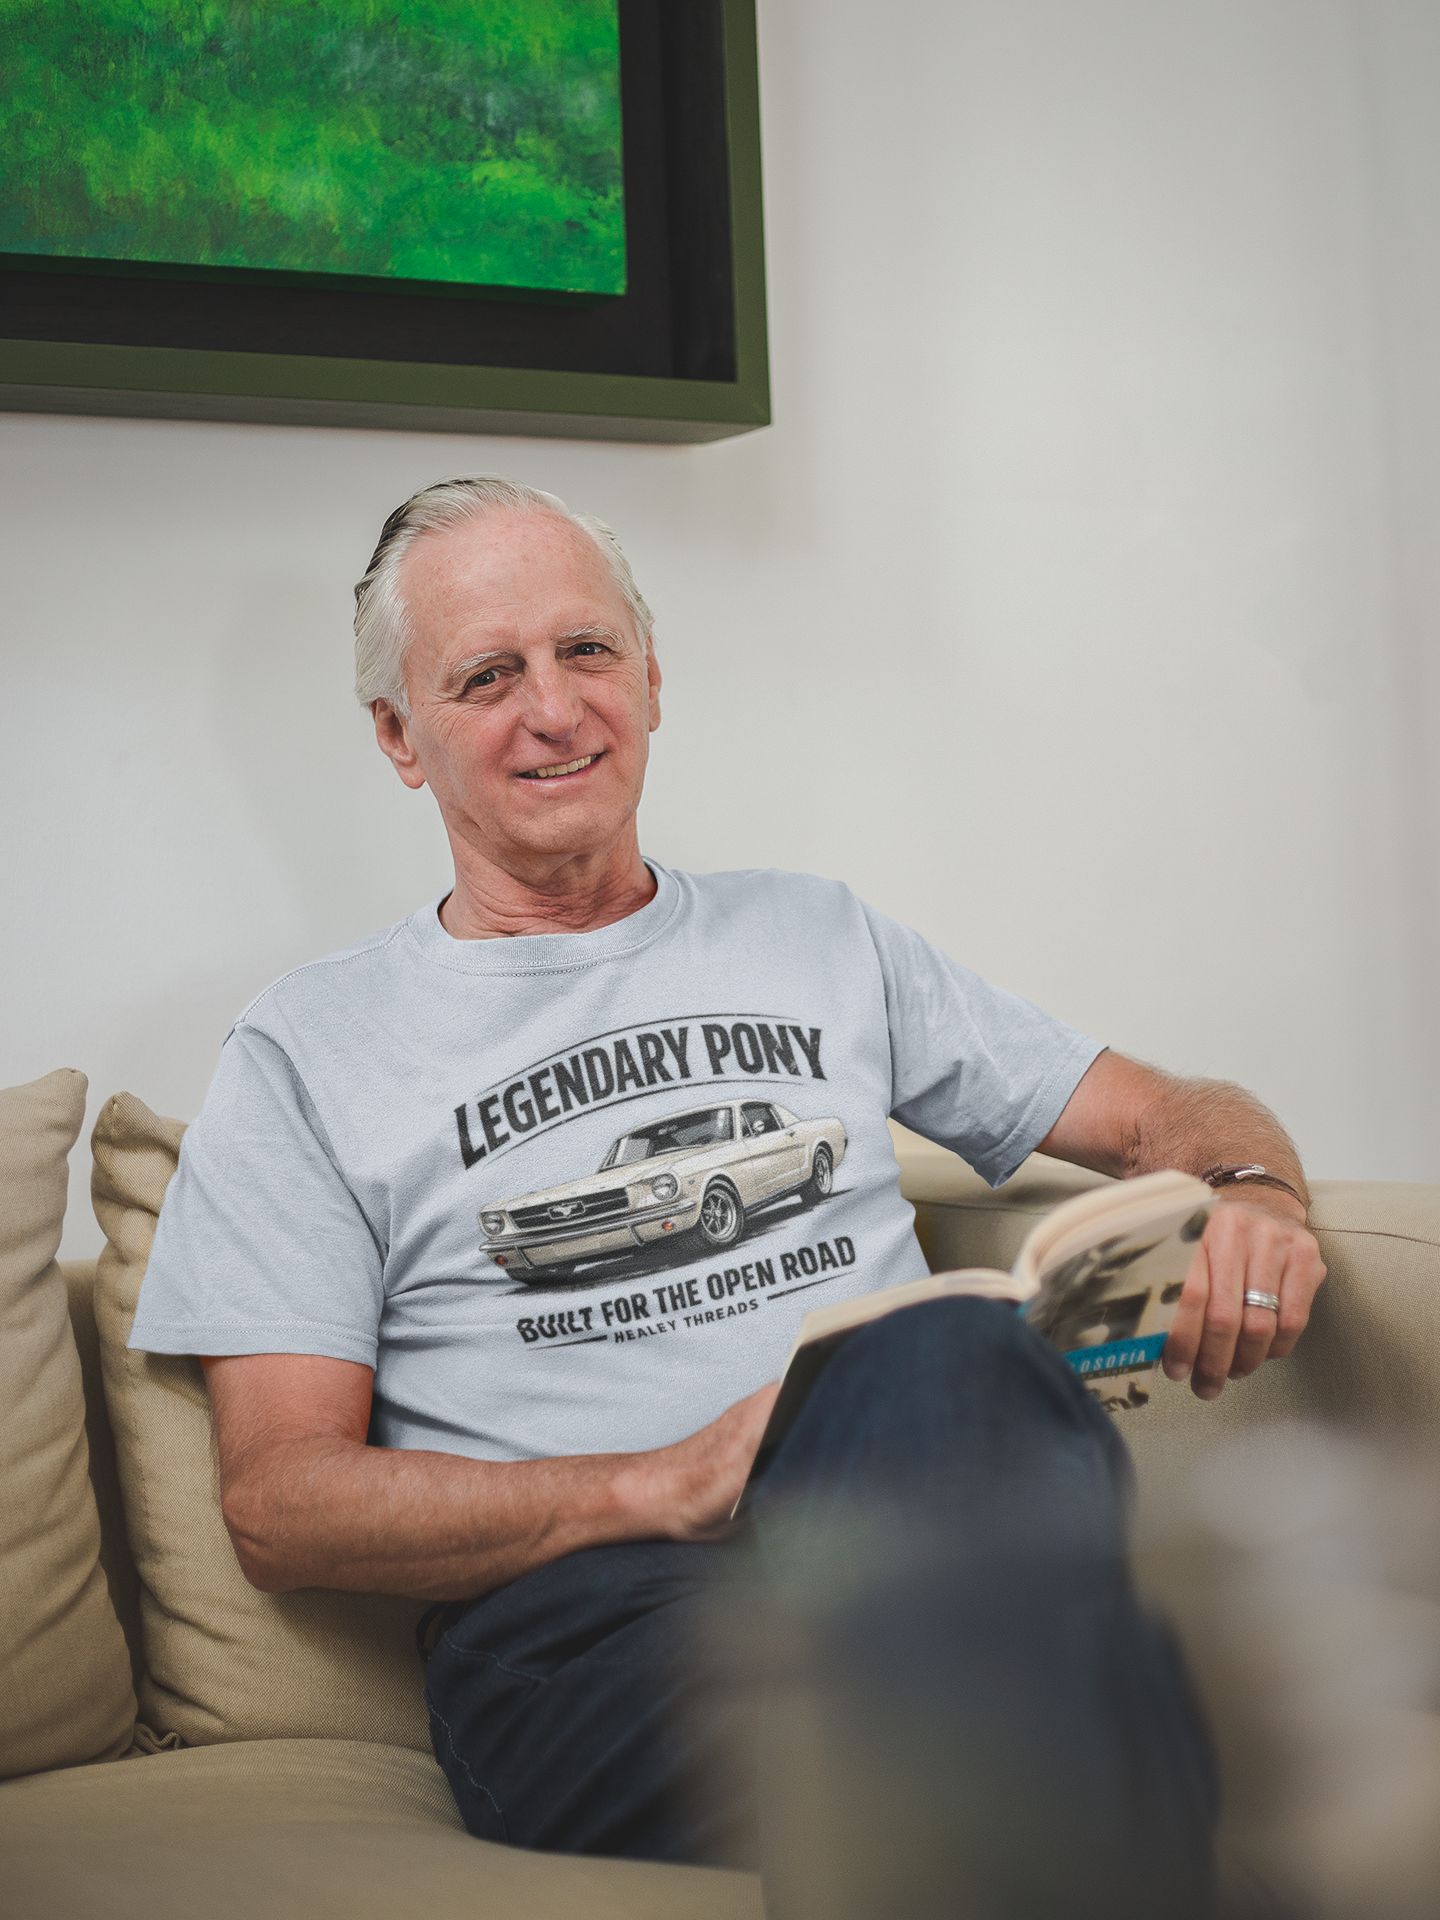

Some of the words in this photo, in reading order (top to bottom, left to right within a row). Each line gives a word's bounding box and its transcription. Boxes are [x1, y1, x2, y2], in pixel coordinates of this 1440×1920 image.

[453, 1026, 693, 1170] LEGENDARY
[701, 1022, 828, 1081] PONY
[516, 1306, 593, 1343] BUILT
[601, 1293, 650, 1327] FOR
[652, 1279, 703, 1314] THE
[706, 1258, 776, 1300] OPEN
[779, 1236, 856, 1281] ROAD
[614, 1320, 677, 1343] HEALEY
[683, 1299, 759, 1328] THREADS
[1075, 1347, 1146, 1374] OSOFÍA
